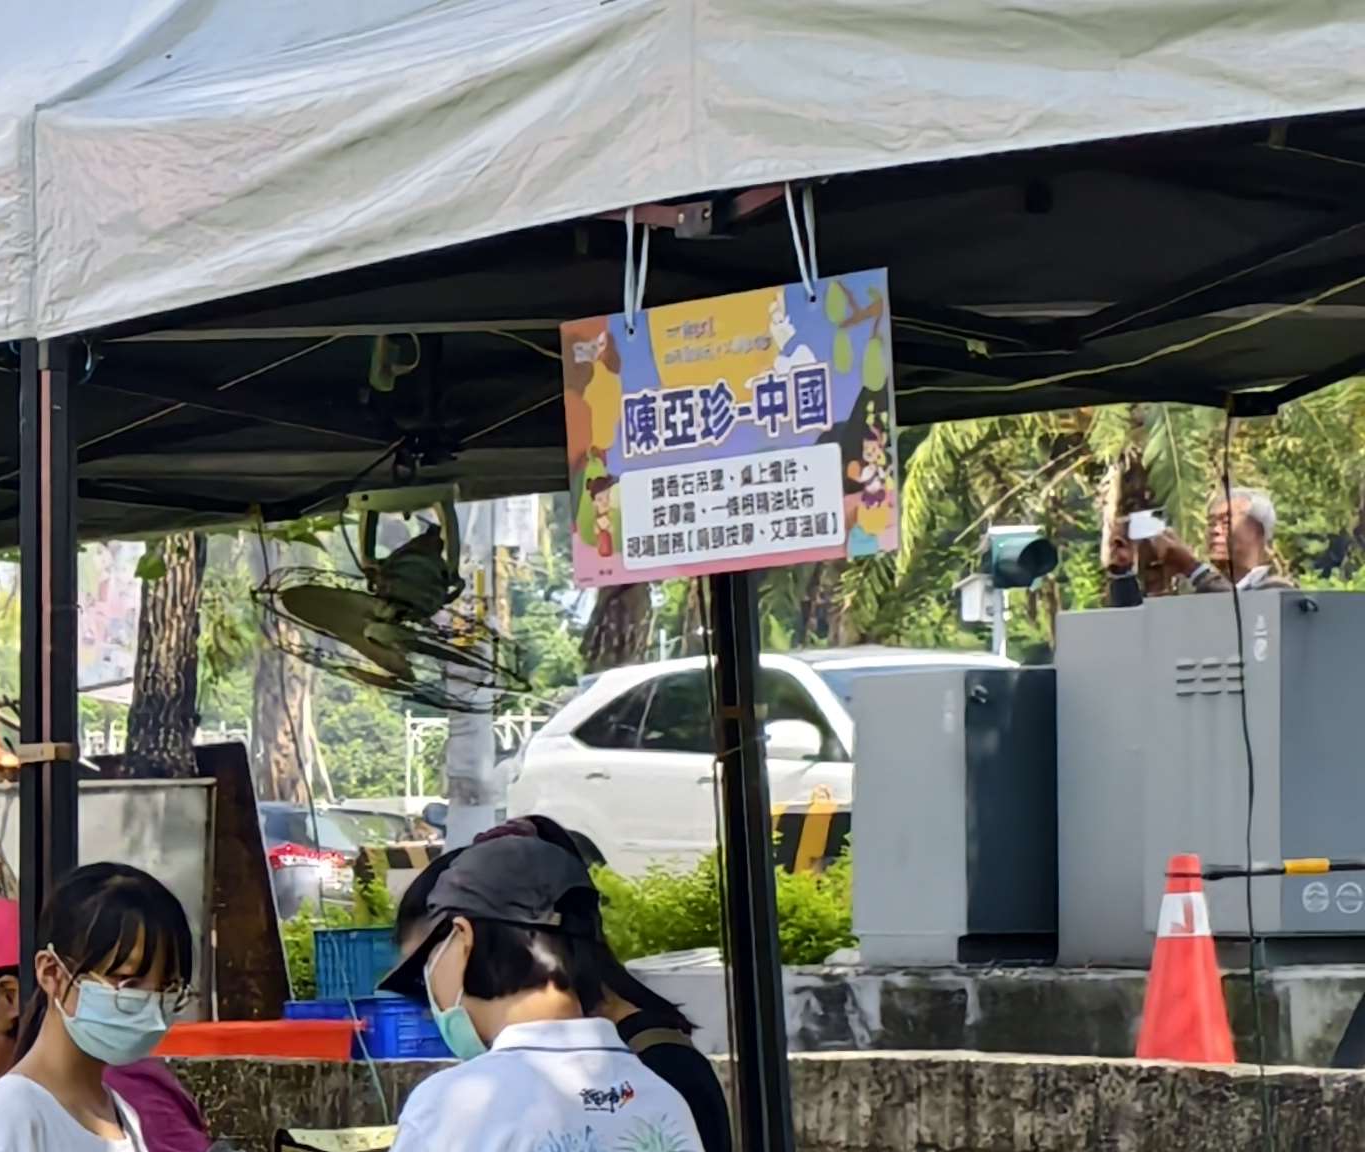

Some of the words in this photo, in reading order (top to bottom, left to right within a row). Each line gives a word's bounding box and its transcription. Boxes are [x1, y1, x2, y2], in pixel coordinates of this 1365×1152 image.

[624, 367, 828, 454] 陳亞珍-中國
